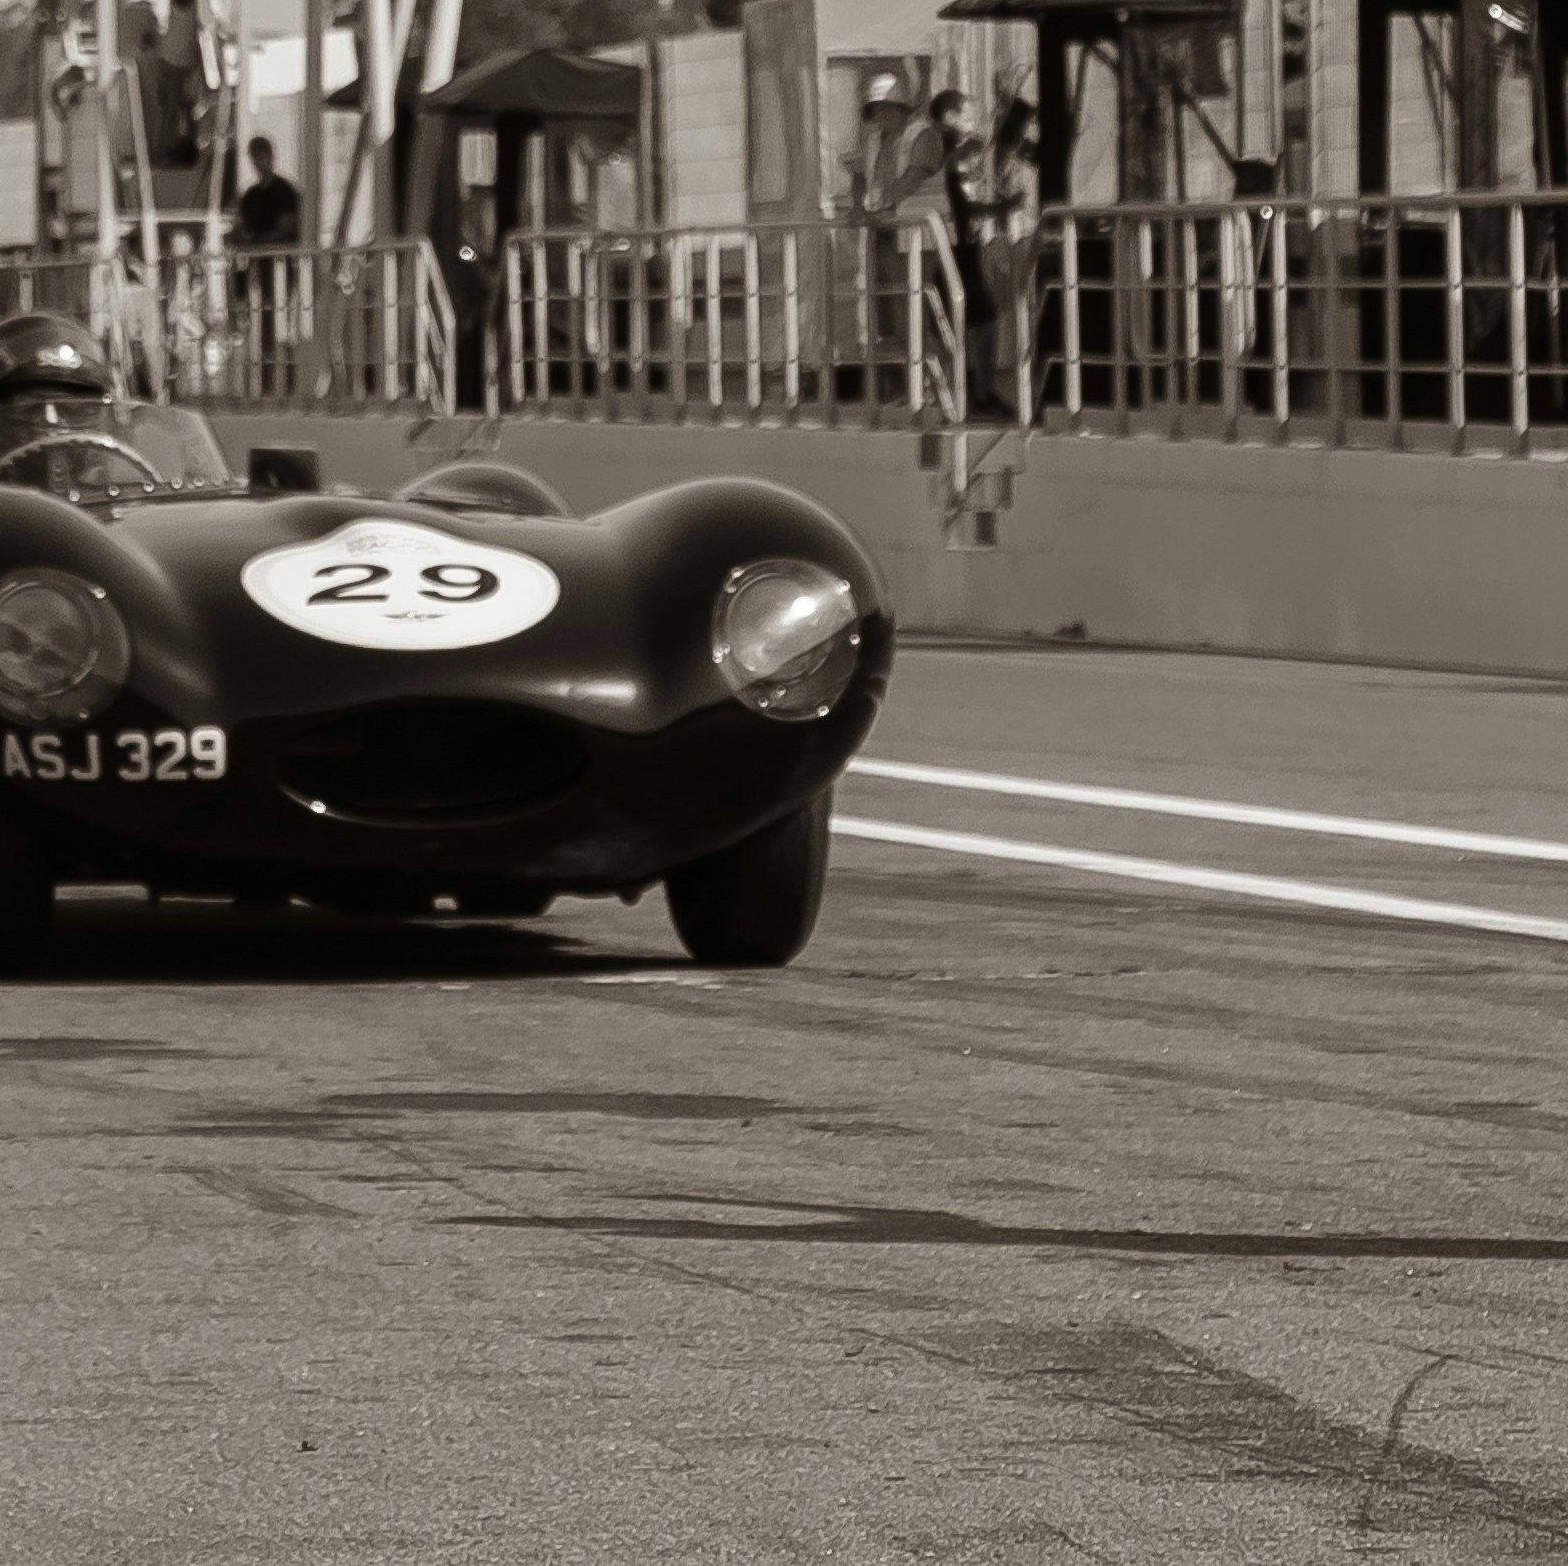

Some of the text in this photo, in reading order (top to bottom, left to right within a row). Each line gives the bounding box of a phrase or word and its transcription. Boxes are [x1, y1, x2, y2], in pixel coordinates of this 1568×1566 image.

[306, 563, 501, 606] 29
[4, 726, 227, 780] ASJ 329
